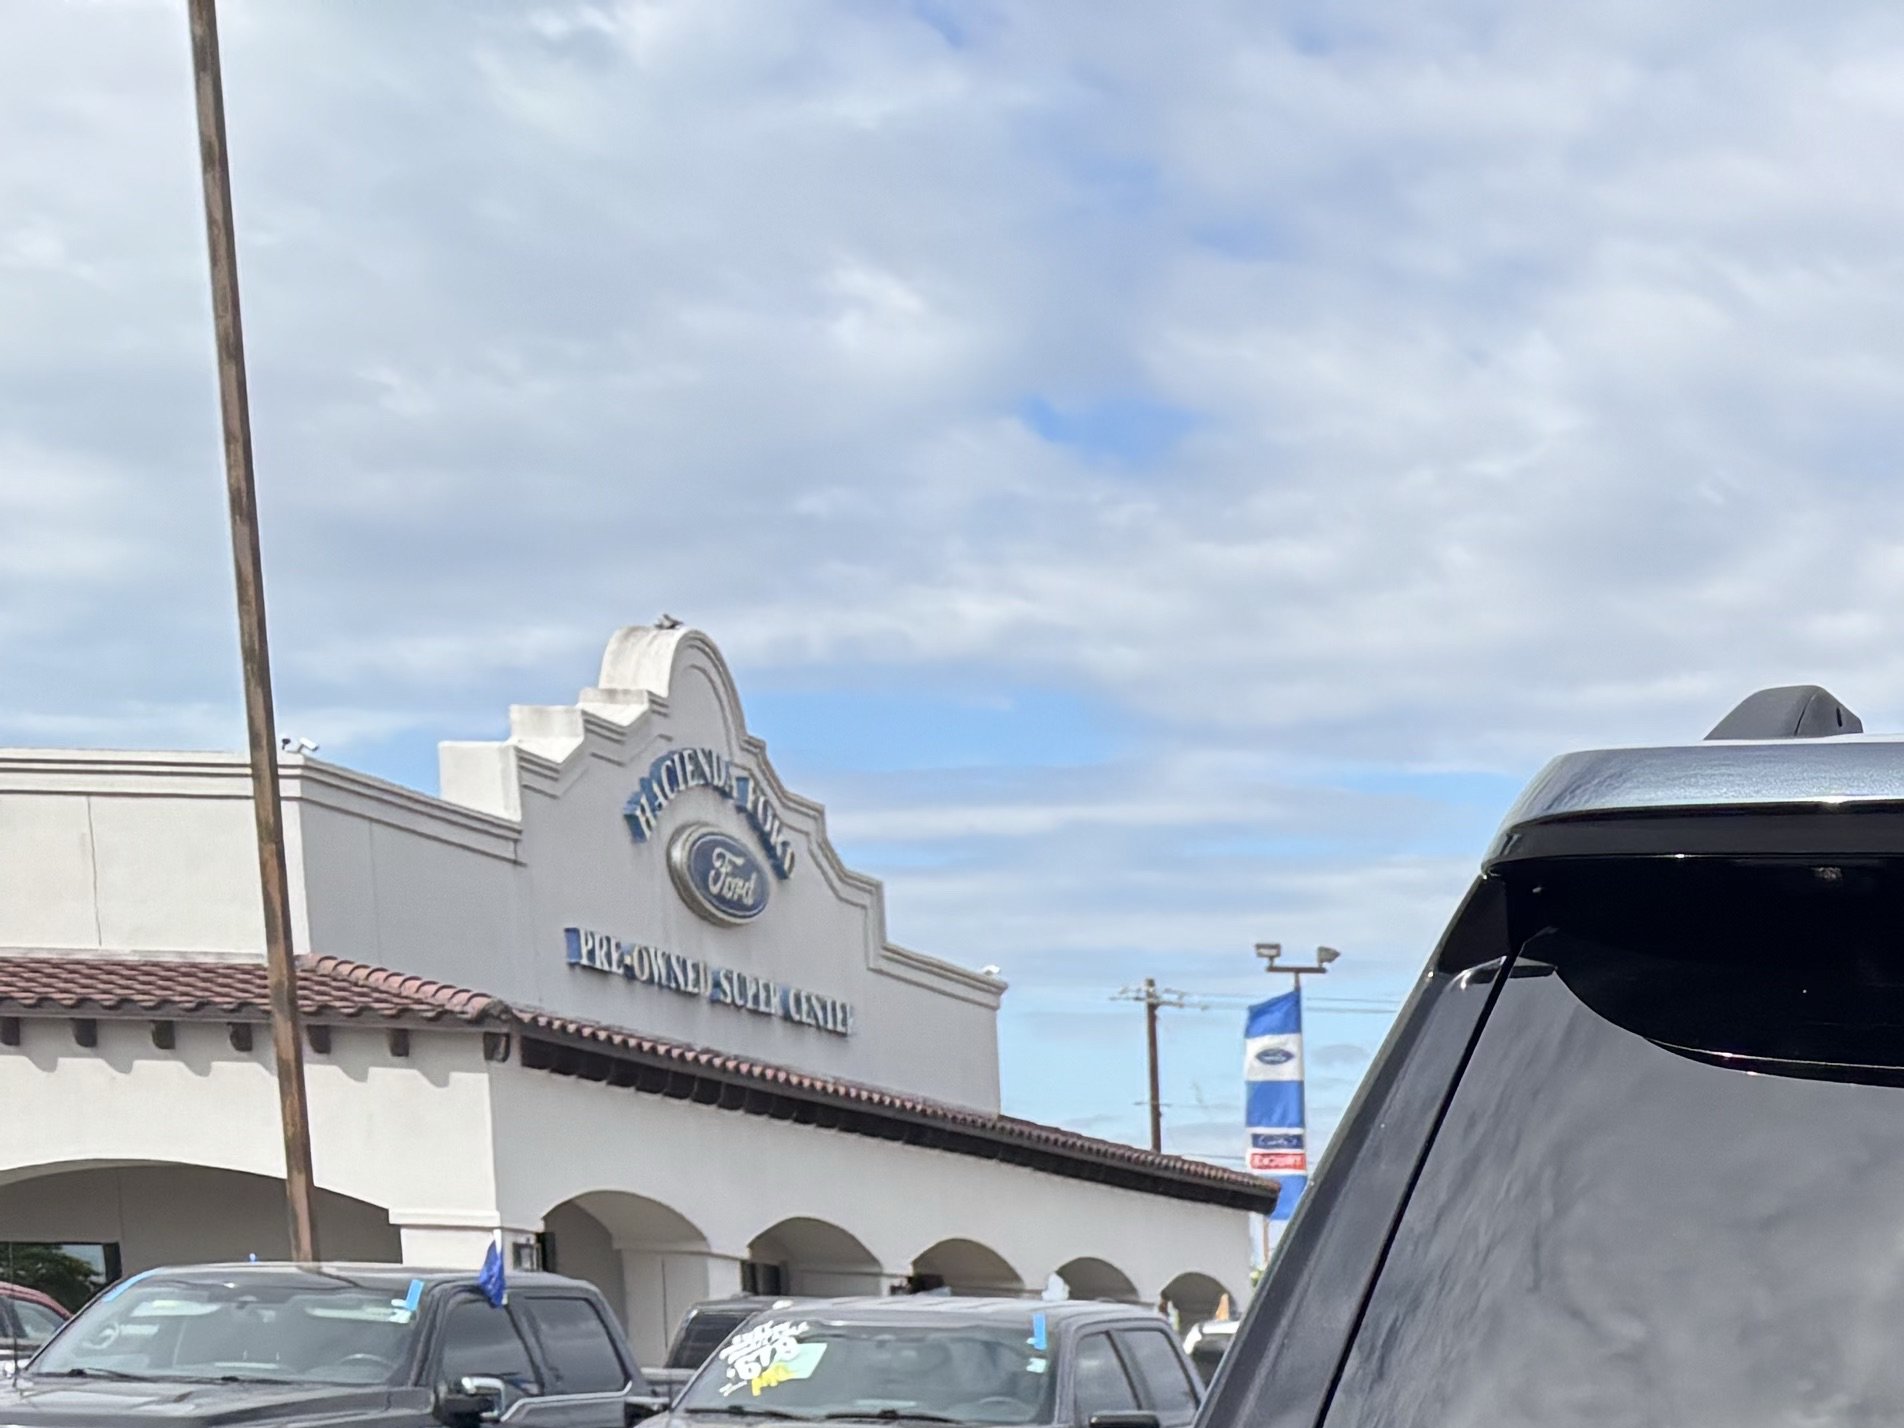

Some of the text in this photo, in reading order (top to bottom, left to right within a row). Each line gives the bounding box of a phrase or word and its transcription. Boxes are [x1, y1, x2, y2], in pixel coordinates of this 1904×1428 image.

[625, 747, 738, 843] HACIENDA
[708, 847, 757, 905] Ford
[571, 927, 712, 998] PRE-OWNED
